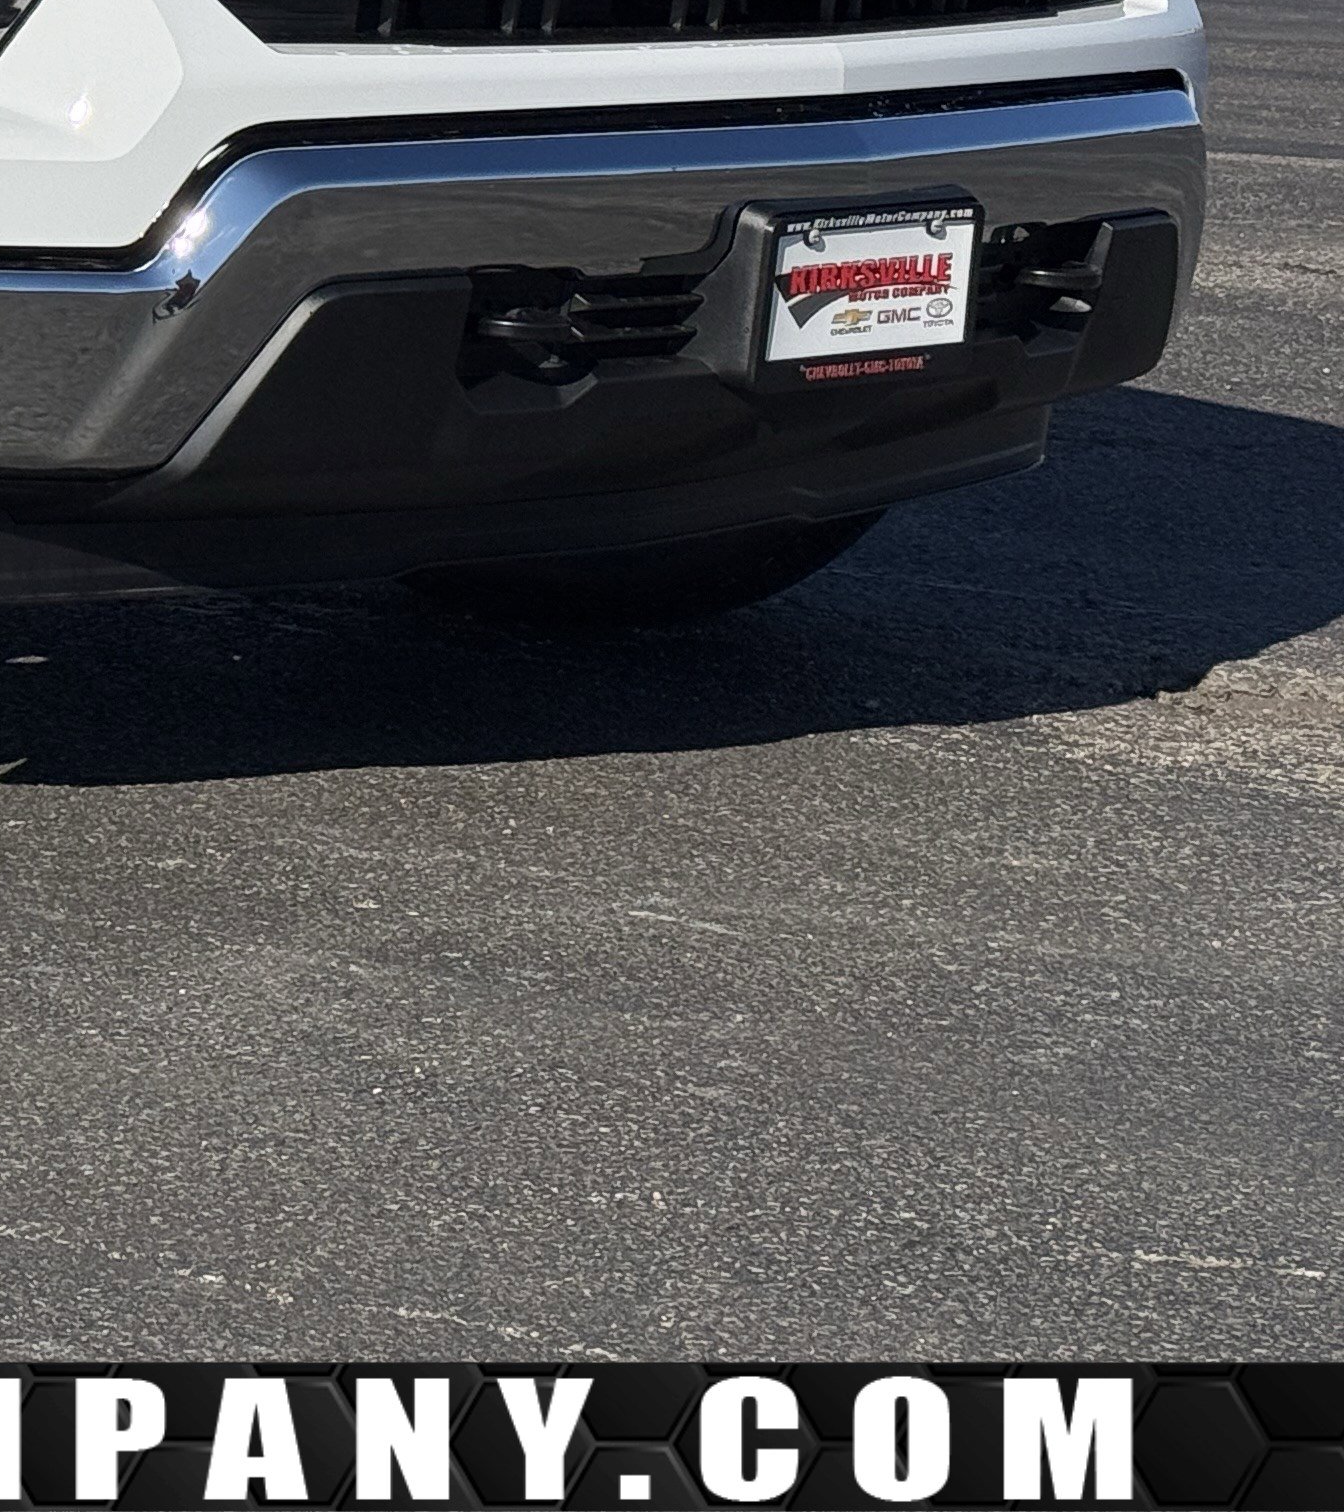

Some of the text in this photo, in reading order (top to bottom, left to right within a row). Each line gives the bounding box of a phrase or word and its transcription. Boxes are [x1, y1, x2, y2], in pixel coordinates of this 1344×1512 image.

[788, 252, 953, 296] KIRKSVILLE
[848, 285, 951, 303] MOTOR COMPANY
[877, 306, 922, 325] GMC
